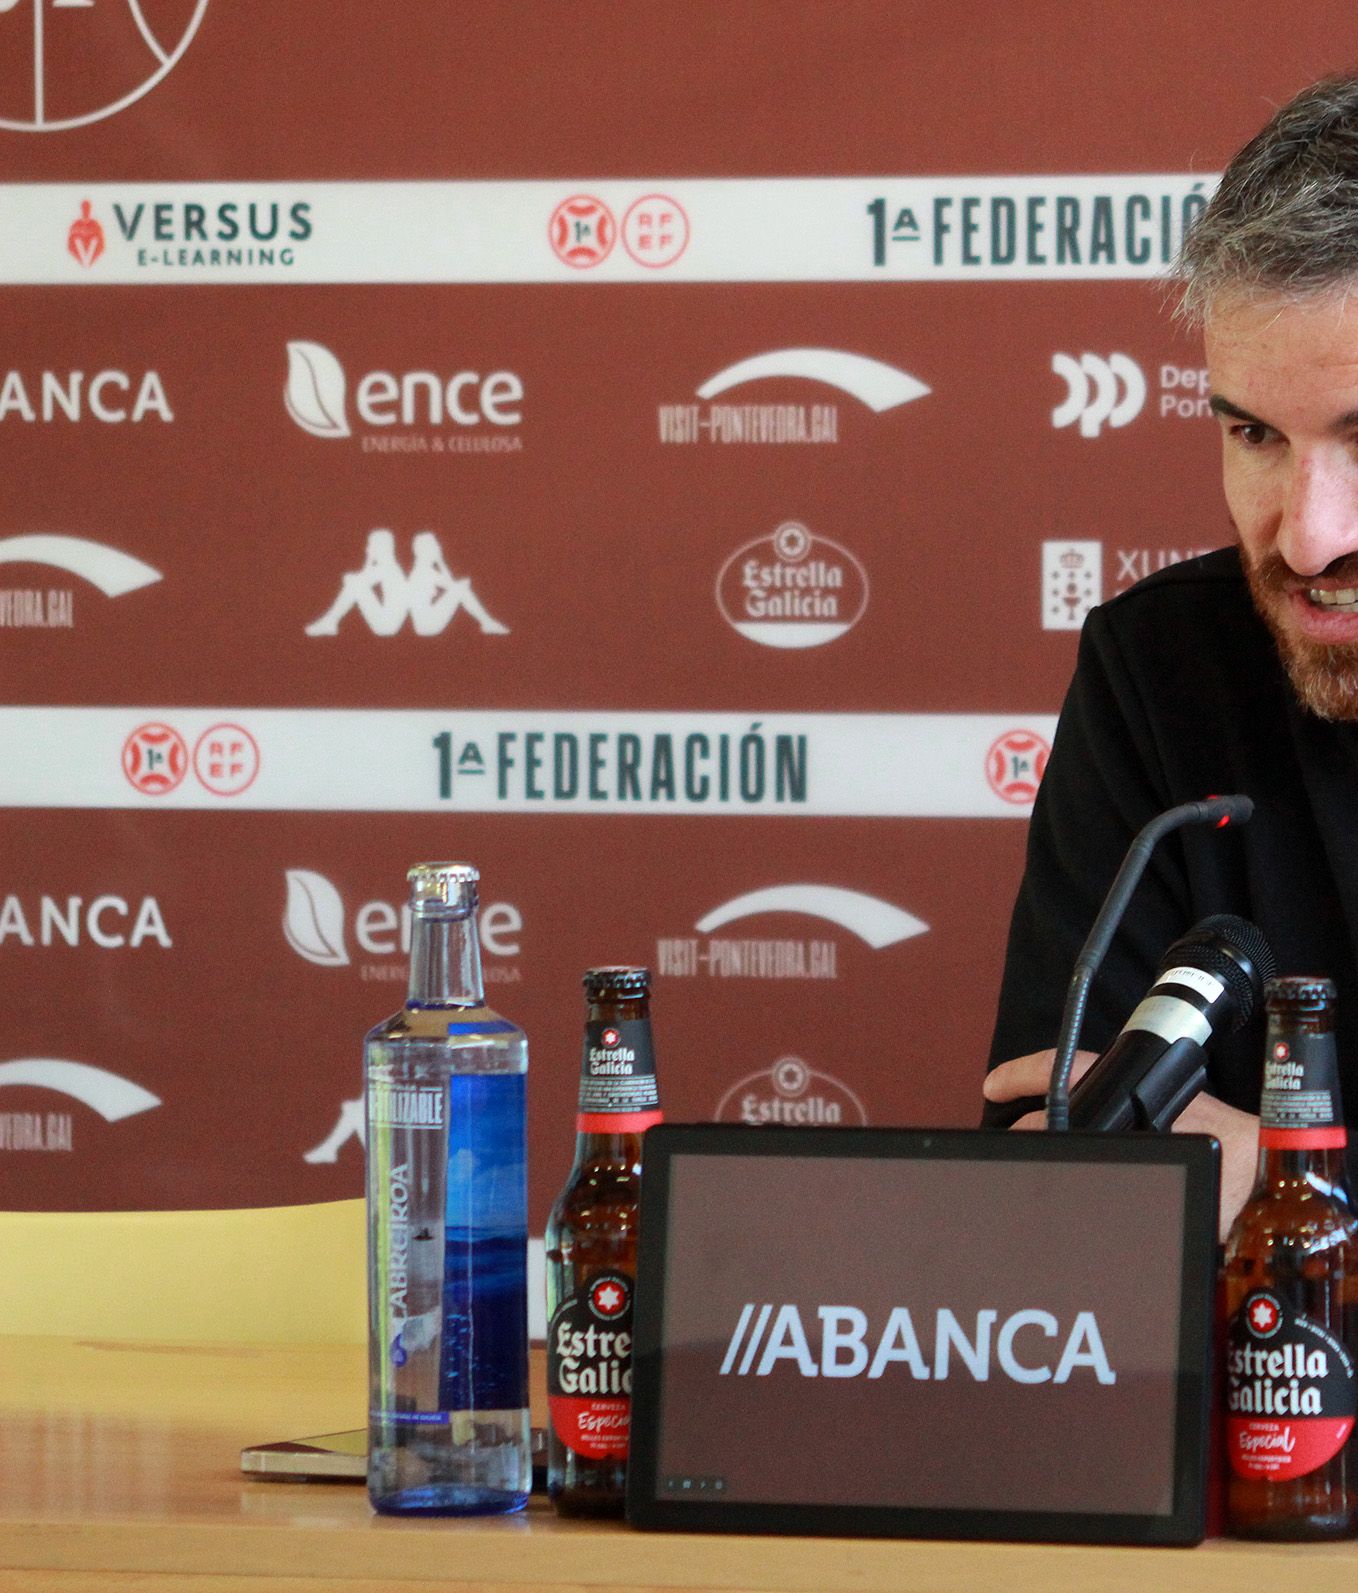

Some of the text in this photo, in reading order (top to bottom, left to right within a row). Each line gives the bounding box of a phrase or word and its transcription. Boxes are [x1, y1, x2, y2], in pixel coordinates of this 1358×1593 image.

[113, 203, 312, 241] VERSUS
[138, 248, 293, 266] E-LEARNING
[357, 371, 523, 425] ence
[743, 559, 843, 589] Estrella
[745, 591, 838, 618] Galicia
[498, 723, 807, 803] FEDERACIÓN
[742, 1094, 841, 1123] Estrella
